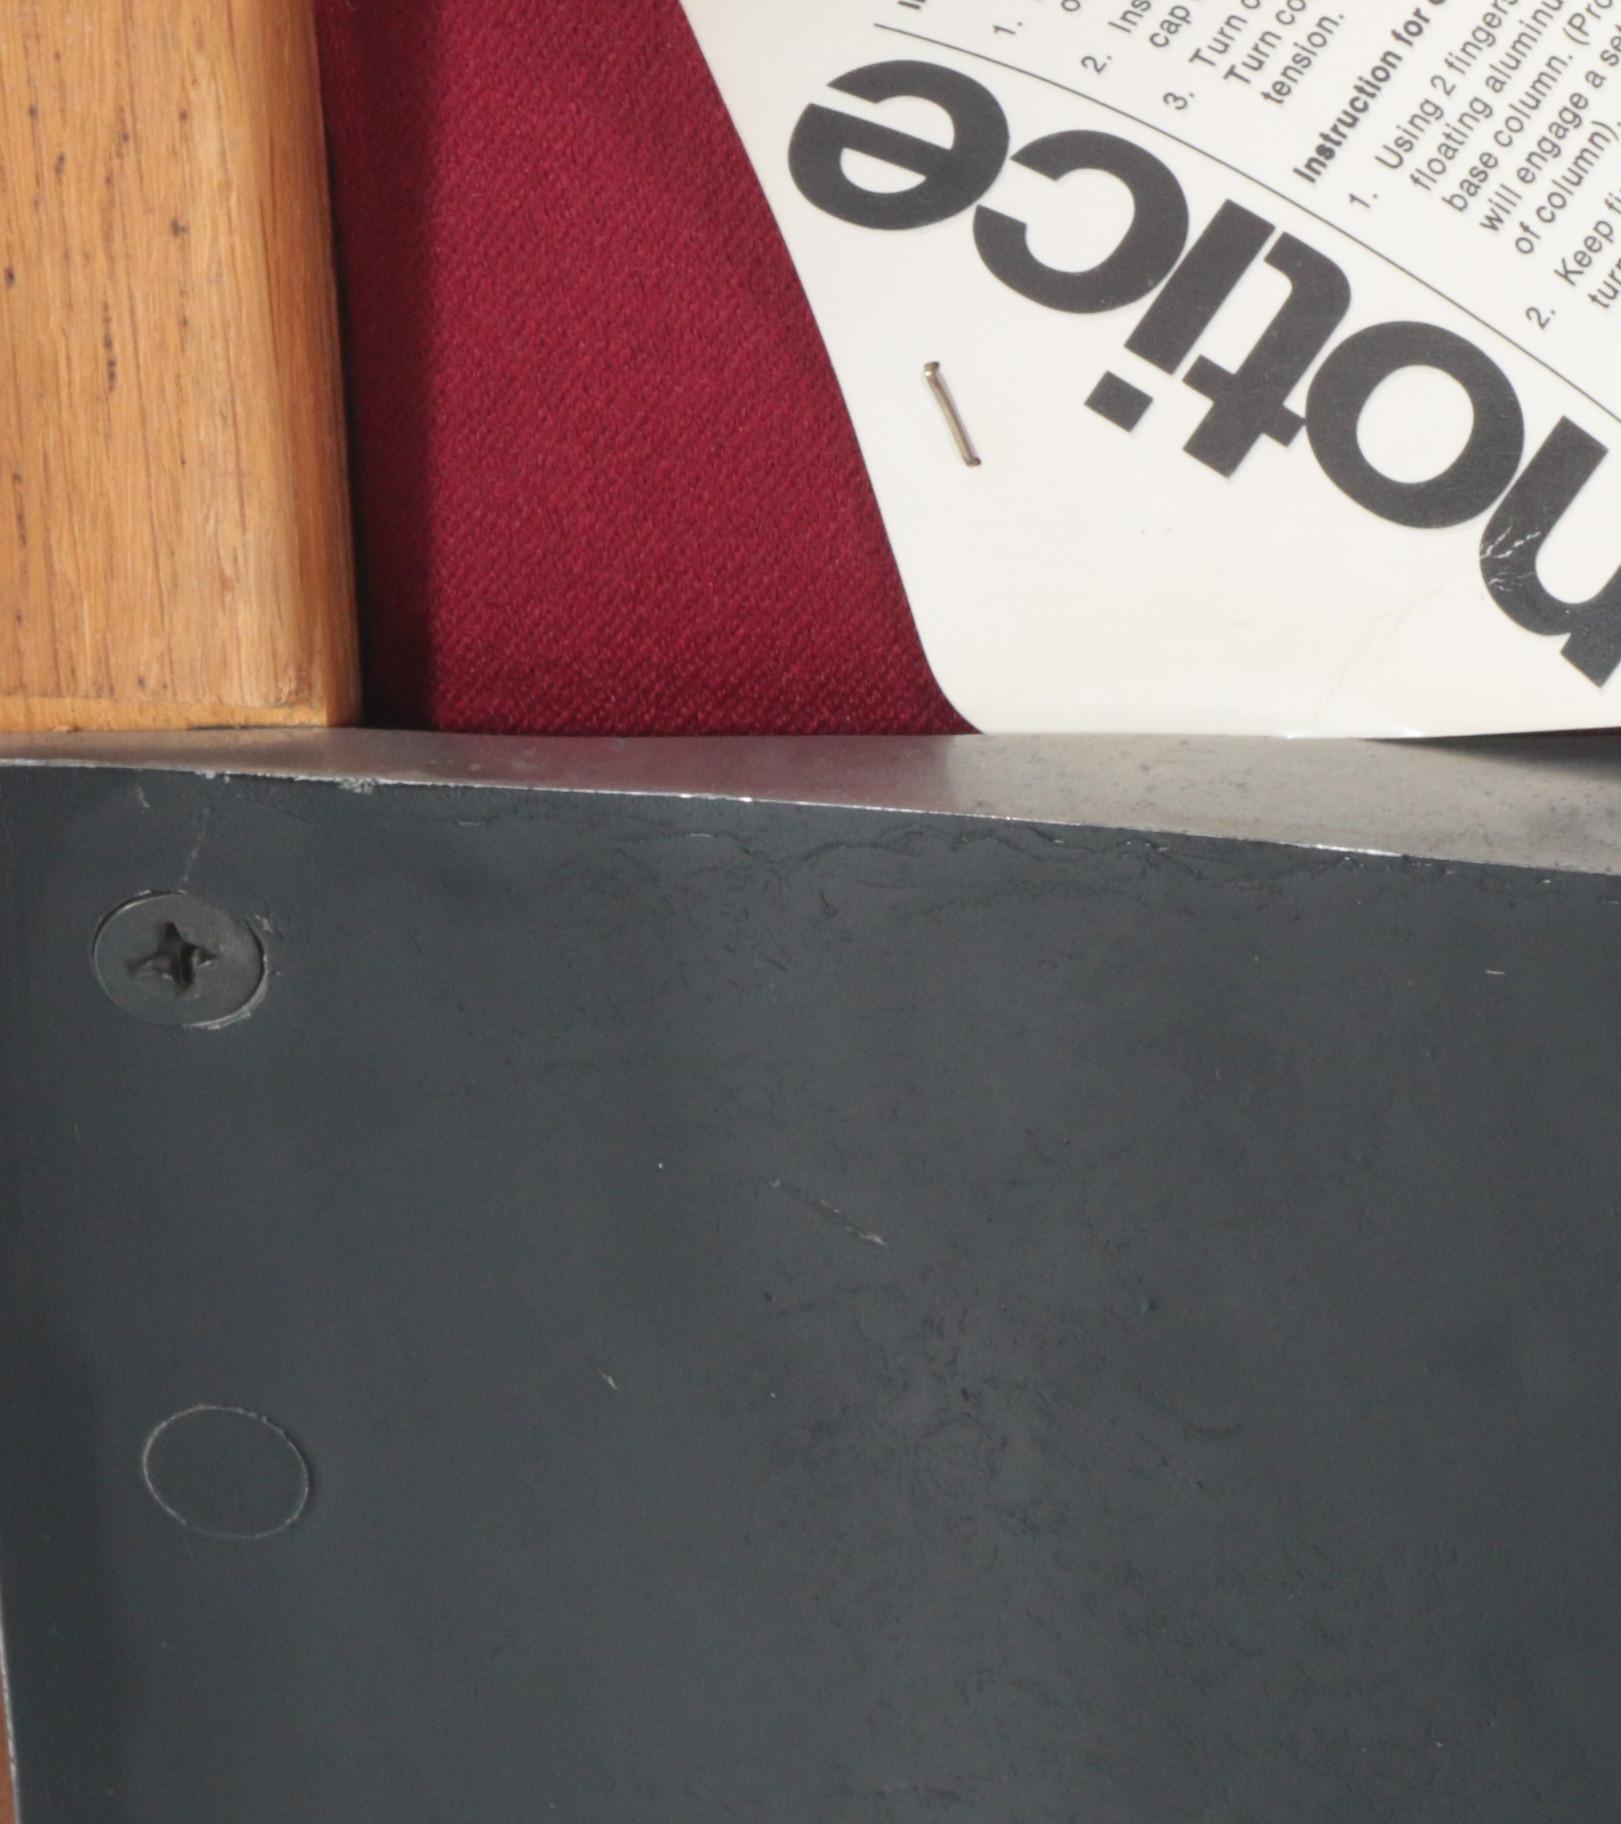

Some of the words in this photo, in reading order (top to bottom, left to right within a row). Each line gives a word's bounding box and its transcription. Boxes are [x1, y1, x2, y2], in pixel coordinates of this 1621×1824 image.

[992, 21, 1023, 35] 1.
[1079, 54, 1112, 75] 2.
[1148, 4, 1191, 48] cap
[1161, 91, 1194, 111] 3.
[1187, 13, 1247, 67] Turn
[1222, 30, 1282, 84] Turn
[1259, 13, 1344, 105] tension.
[1291, 49, 1403, 184] Instruction
[1389, 6, 1431, 47] for
[1348, 192, 1377, 209] 1.
[1373, 97, 1445, 170] Using
[1429, 74, 1456, 97] 2
[1408, 95, 1494, 191] floating
[1440, 151, 1499, 213] base
[1492, 54, 1573, 148] column.
[1478, 182, 1522, 232] will
[1515, 91, 1589, 185] engage
[1583, 69, 1606, 89] a
[1513, 220, 1541, 255] of
[1534, 119, 1621, 224] column).
[1524, 305, 1556, 330] 2.
[1552, 219, 1614, 287] Keep
